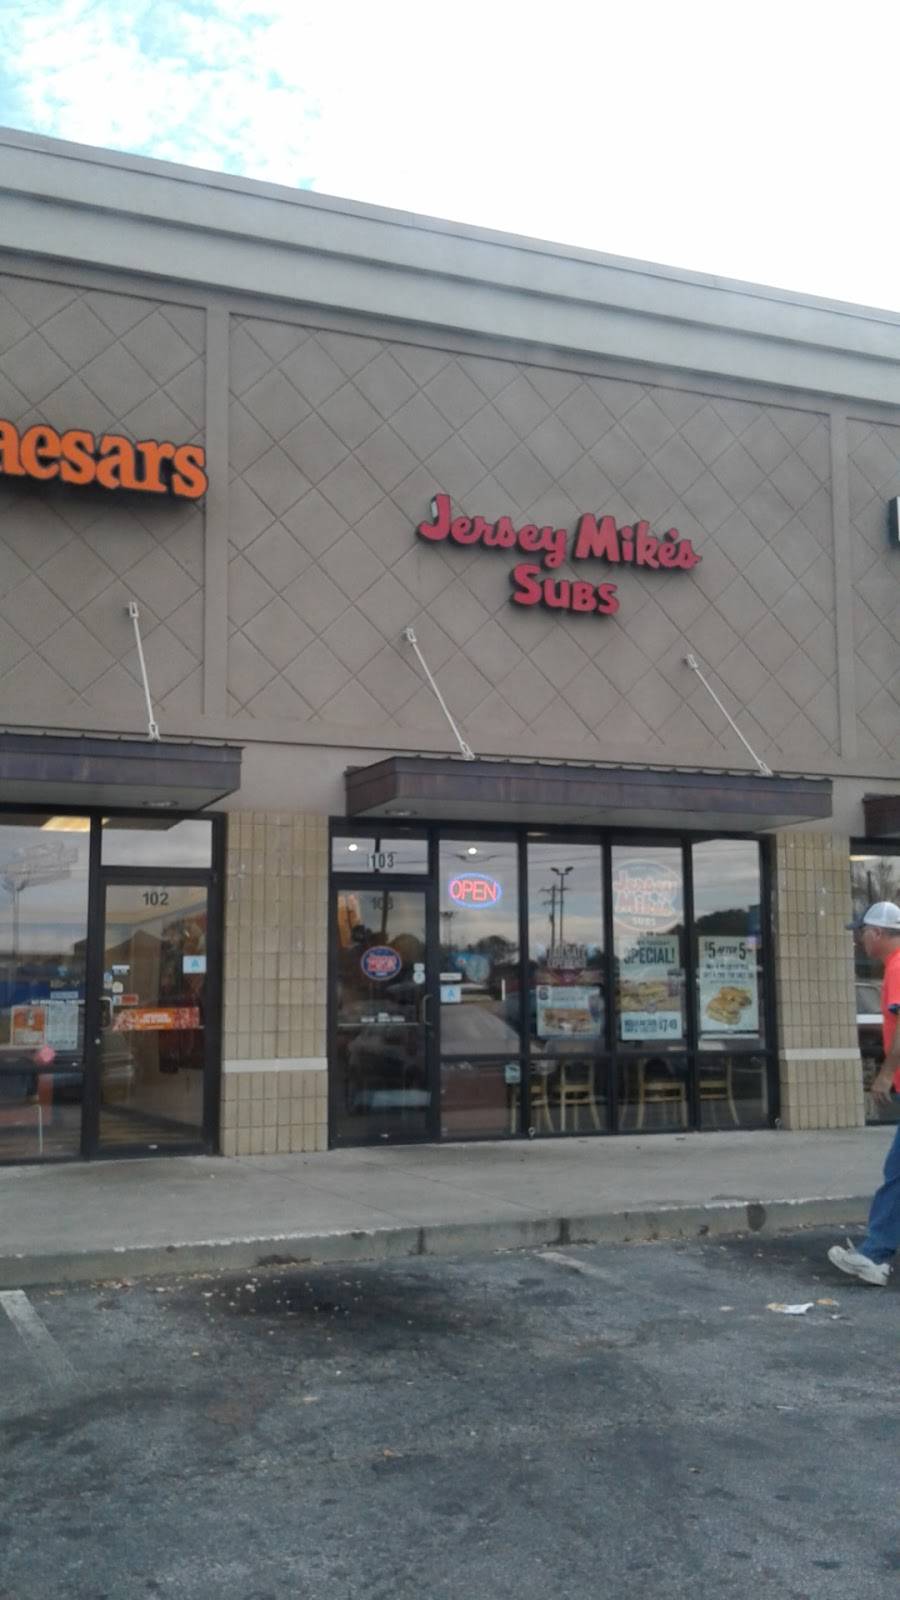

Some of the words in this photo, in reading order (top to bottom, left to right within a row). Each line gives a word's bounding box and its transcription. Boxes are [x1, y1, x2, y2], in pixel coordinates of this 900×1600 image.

[417, 493, 568, 568] Jersey
[573, 512, 702, 569] Mike's
[370, 852, 394, 868] 103
[142, 892, 169, 906] 102
[450, 879, 497, 902] OPEN
[623, 947, 675, 964] SPECIAL!
